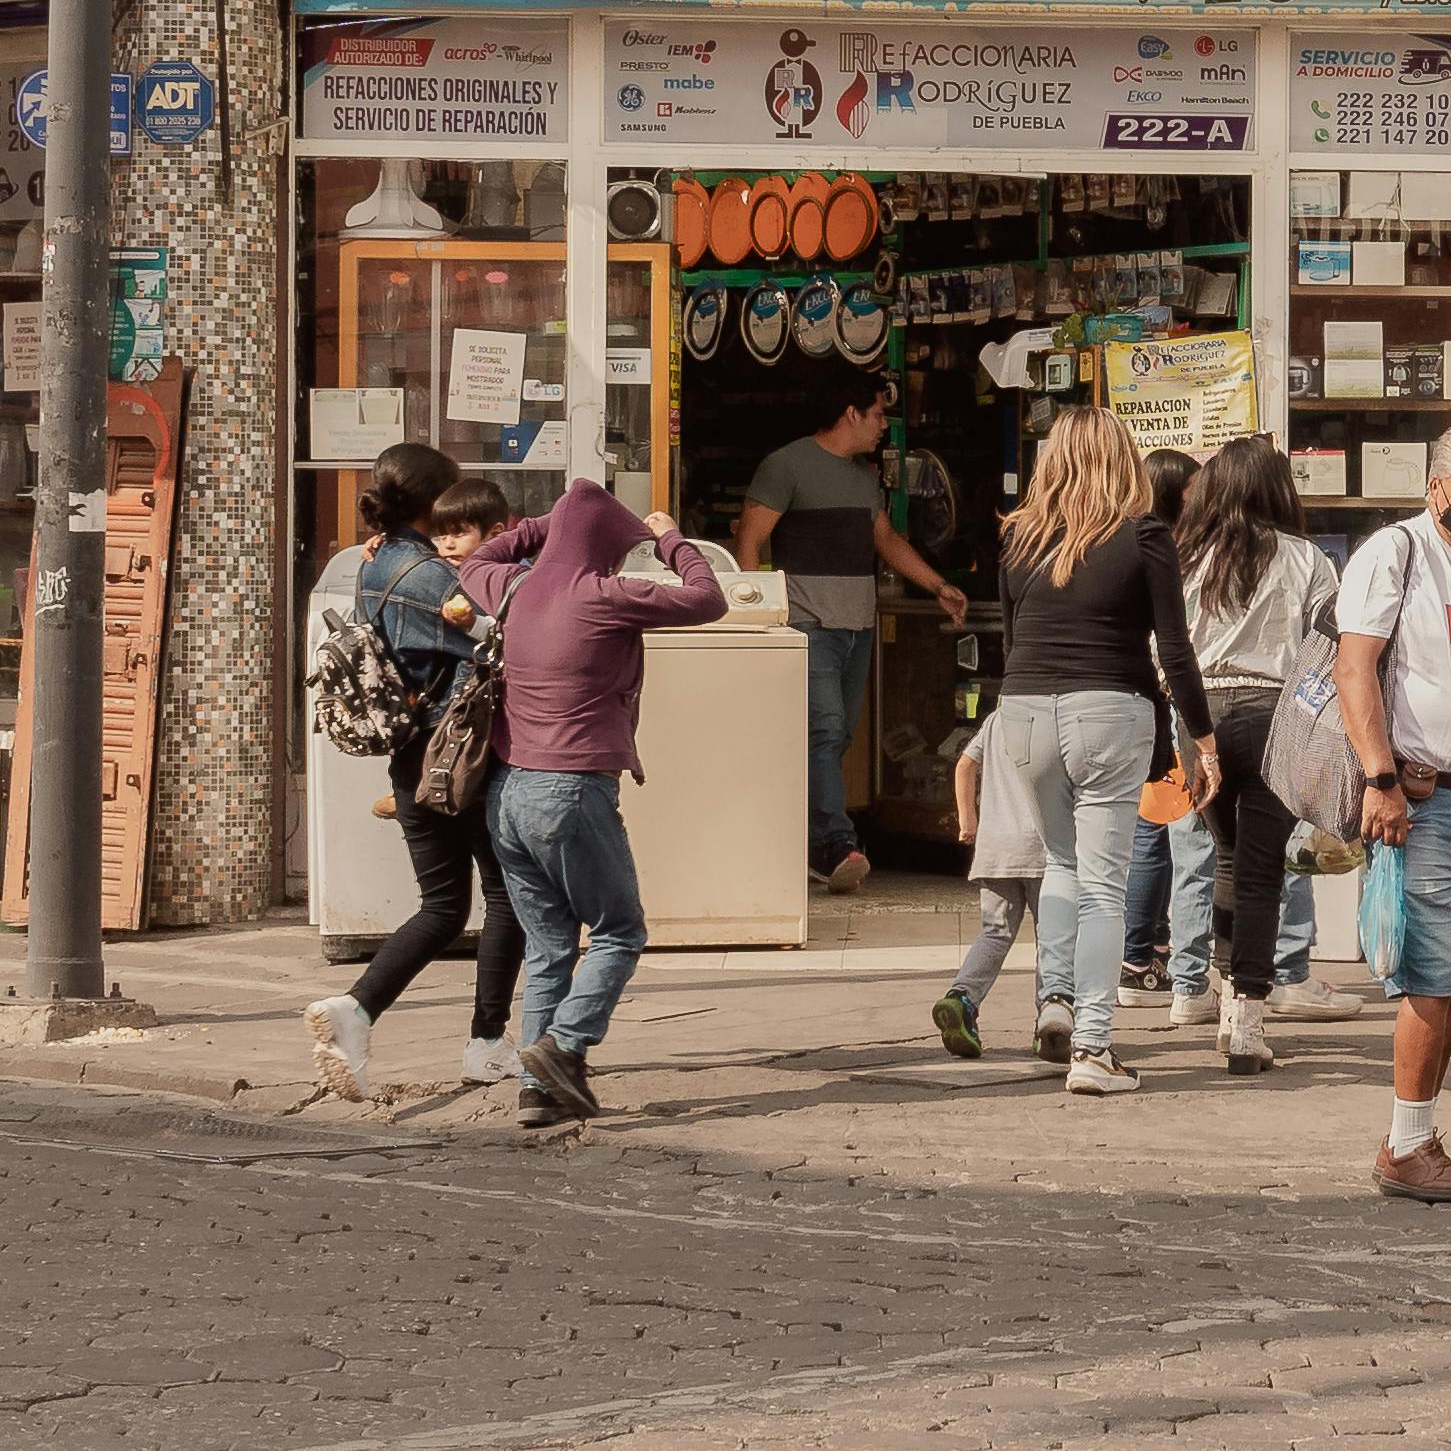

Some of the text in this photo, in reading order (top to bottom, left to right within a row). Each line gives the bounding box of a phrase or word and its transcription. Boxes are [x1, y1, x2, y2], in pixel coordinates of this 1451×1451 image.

[341, 38, 417, 53] DISTRIBUIDOR
[622, 29, 667, 48] Oster
[1218, 40, 1239, 52] LG
[444, 47, 487, 61] acros
[667, 44, 694, 56] IEM
[1140, 41, 1165, 55] Easy
[333, 51, 423, 66] AUTORIZADO DE:
[1299, 49, 1396, 66] SERVICIO
[620, 61, 669, 70] PRESTO
[1296, 66, 1394, 79] A DOMICILIO
[1145, 70, 1183, 78] DAEWOO
[663, 74, 715, 90] mabe
[146, 81, 200, 110] ADT
[323, 75, 558, 105] REFACCIONES ORIGINALES Y
[1126, 90, 1163, 103] EKCO
[1181, 96, 1250, 105] Hamilton Beach
[1336, 92, 1373, 109] 222
[1380, 92, 1418, 109] 232
[1425, 93, 1450, 110] 10
[333, 106, 547, 136] SERVICIO DE REPARACIÓN
[972, 116, 1066, 131] DE PUEBLA
[1336, 110, 1373, 127] 222
[1380, 111, 1418, 127] 246
[1425, 111, 1449, 128] 07
[620, 123, 668, 132] SAMSUNG
[1117, 118, 1233, 144] 222-A
[1336, 128, 1372, 144] 221
[1380, 128, 1418, 145] 147
[1425, 129, 1449, 145] 20
[608, 362, 638, 374] VISA
[1115, 398, 1192, 416] REPARACION
[1131, 416, 1189, 432] VENTA DE
